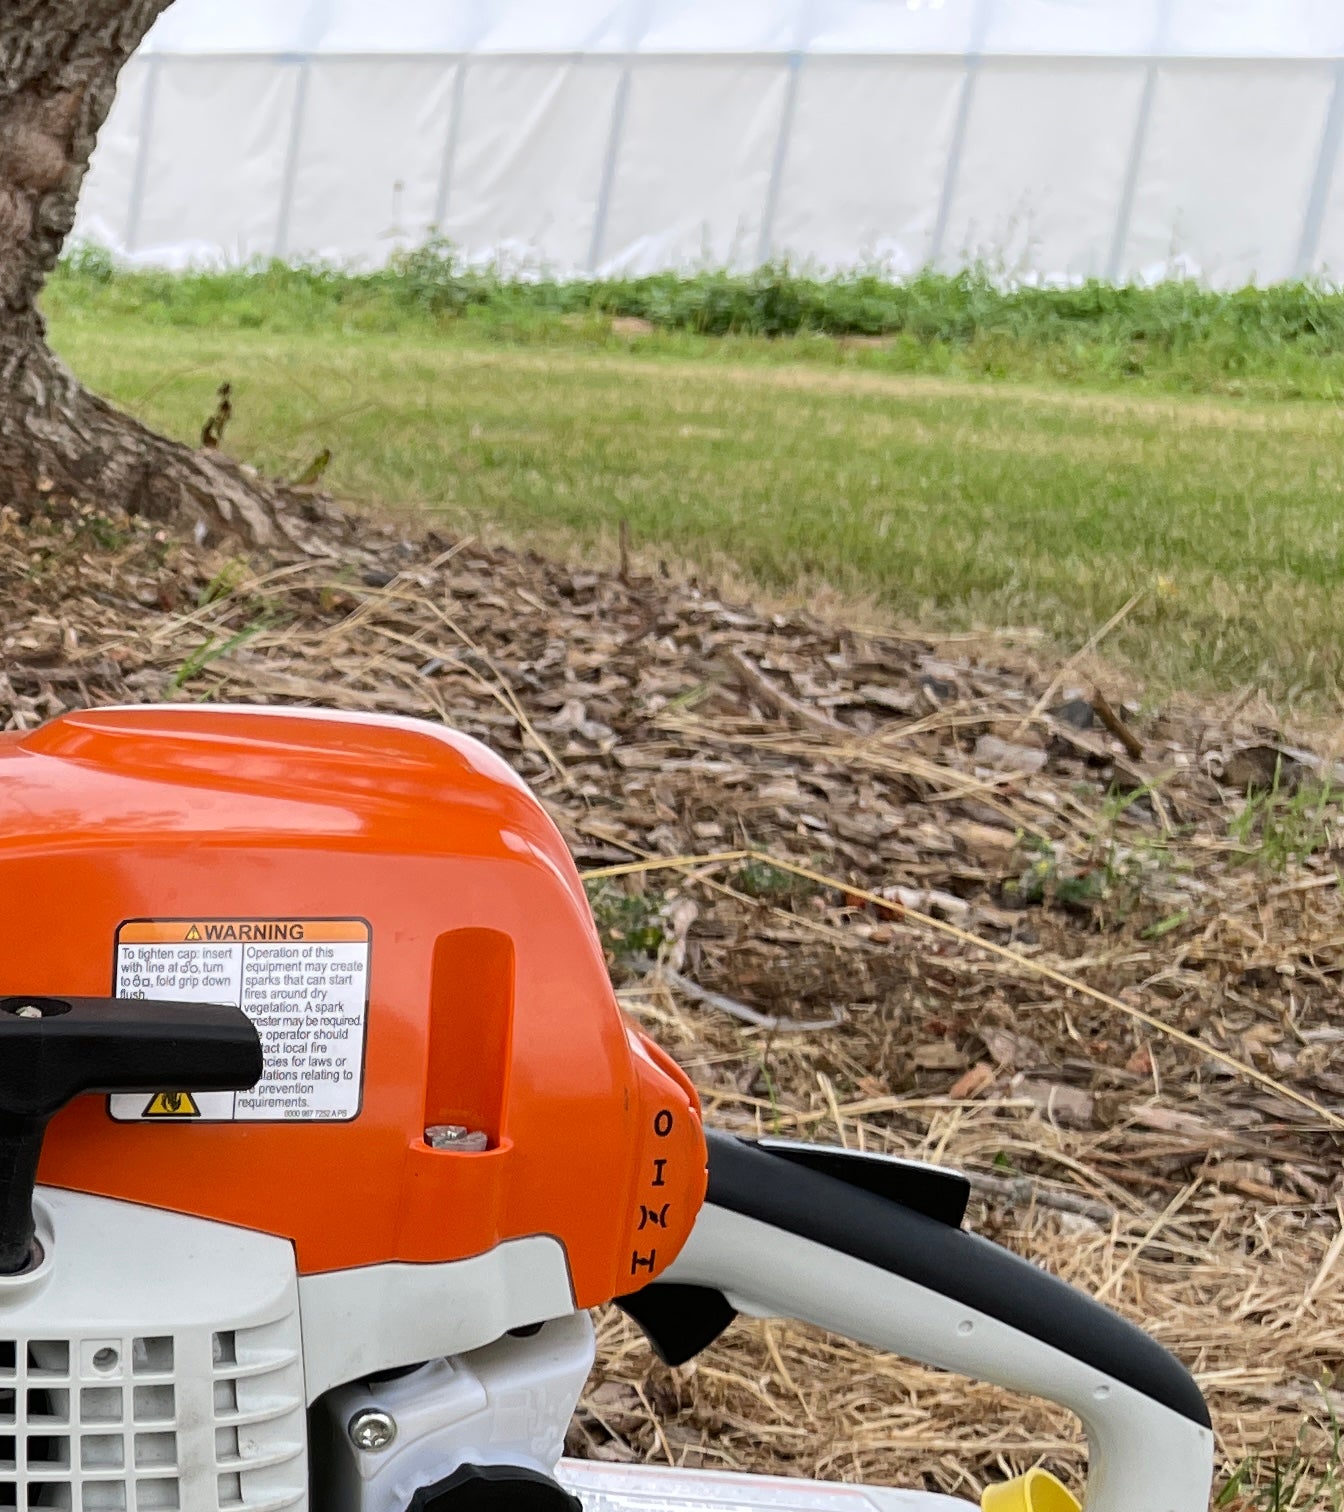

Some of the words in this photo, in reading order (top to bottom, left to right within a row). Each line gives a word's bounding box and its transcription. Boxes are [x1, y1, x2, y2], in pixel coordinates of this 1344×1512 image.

[205, 924, 304, 940] WARNING
[122, 948, 135, 960] To
[138, 947, 174, 962] tighten
[202, 947, 233, 959] insert
[246, 946, 299, 960] Operation
[301, 946, 313, 958] of
[315, 946, 334, 958] this
[121, 961, 143, 973] with
[146, 961, 165, 973] line
[168, 961, 179, 973] at
[245, 961, 302, 975] equipment
[304, 963, 328, 975] may
[330, 961, 364, 972] create
[120, 976, 130, 986] to
[156, 975, 176, 986] fold
[179, 976, 199, 989] grip
[202, 975, 231, 986] down
[245, 975, 280, 988] sparks
[283, 975, 304, 985] that
[306, 976, 326, 985] can
[329, 975, 353, 985] start
[244, 988, 267, 999] fires
[270, 988, 307, 999] around
[310, 988, 328, 1002] dry
[304, 1001, 313, 1012] A
[315, 1001, 345, 1015] spark
[282, 1017, 303, 1030] may
[305, 1015, 319, 1026] be
[265, 1030, 311, 1042] operator
[313, 1029, 349, 1040] should
[283, 1042, 308, 1053] local
[310, 1042, 328, 1053] fire
[291, 1056, 306, 1067] for
[308, 1056, 332, 1067] laws
[335, 1058, 347, 1067] or
[300, 1069, 340, 1083] relating
[343, 1070, 353, 1081] to
[258, 1083, 314, 1096] prevention
